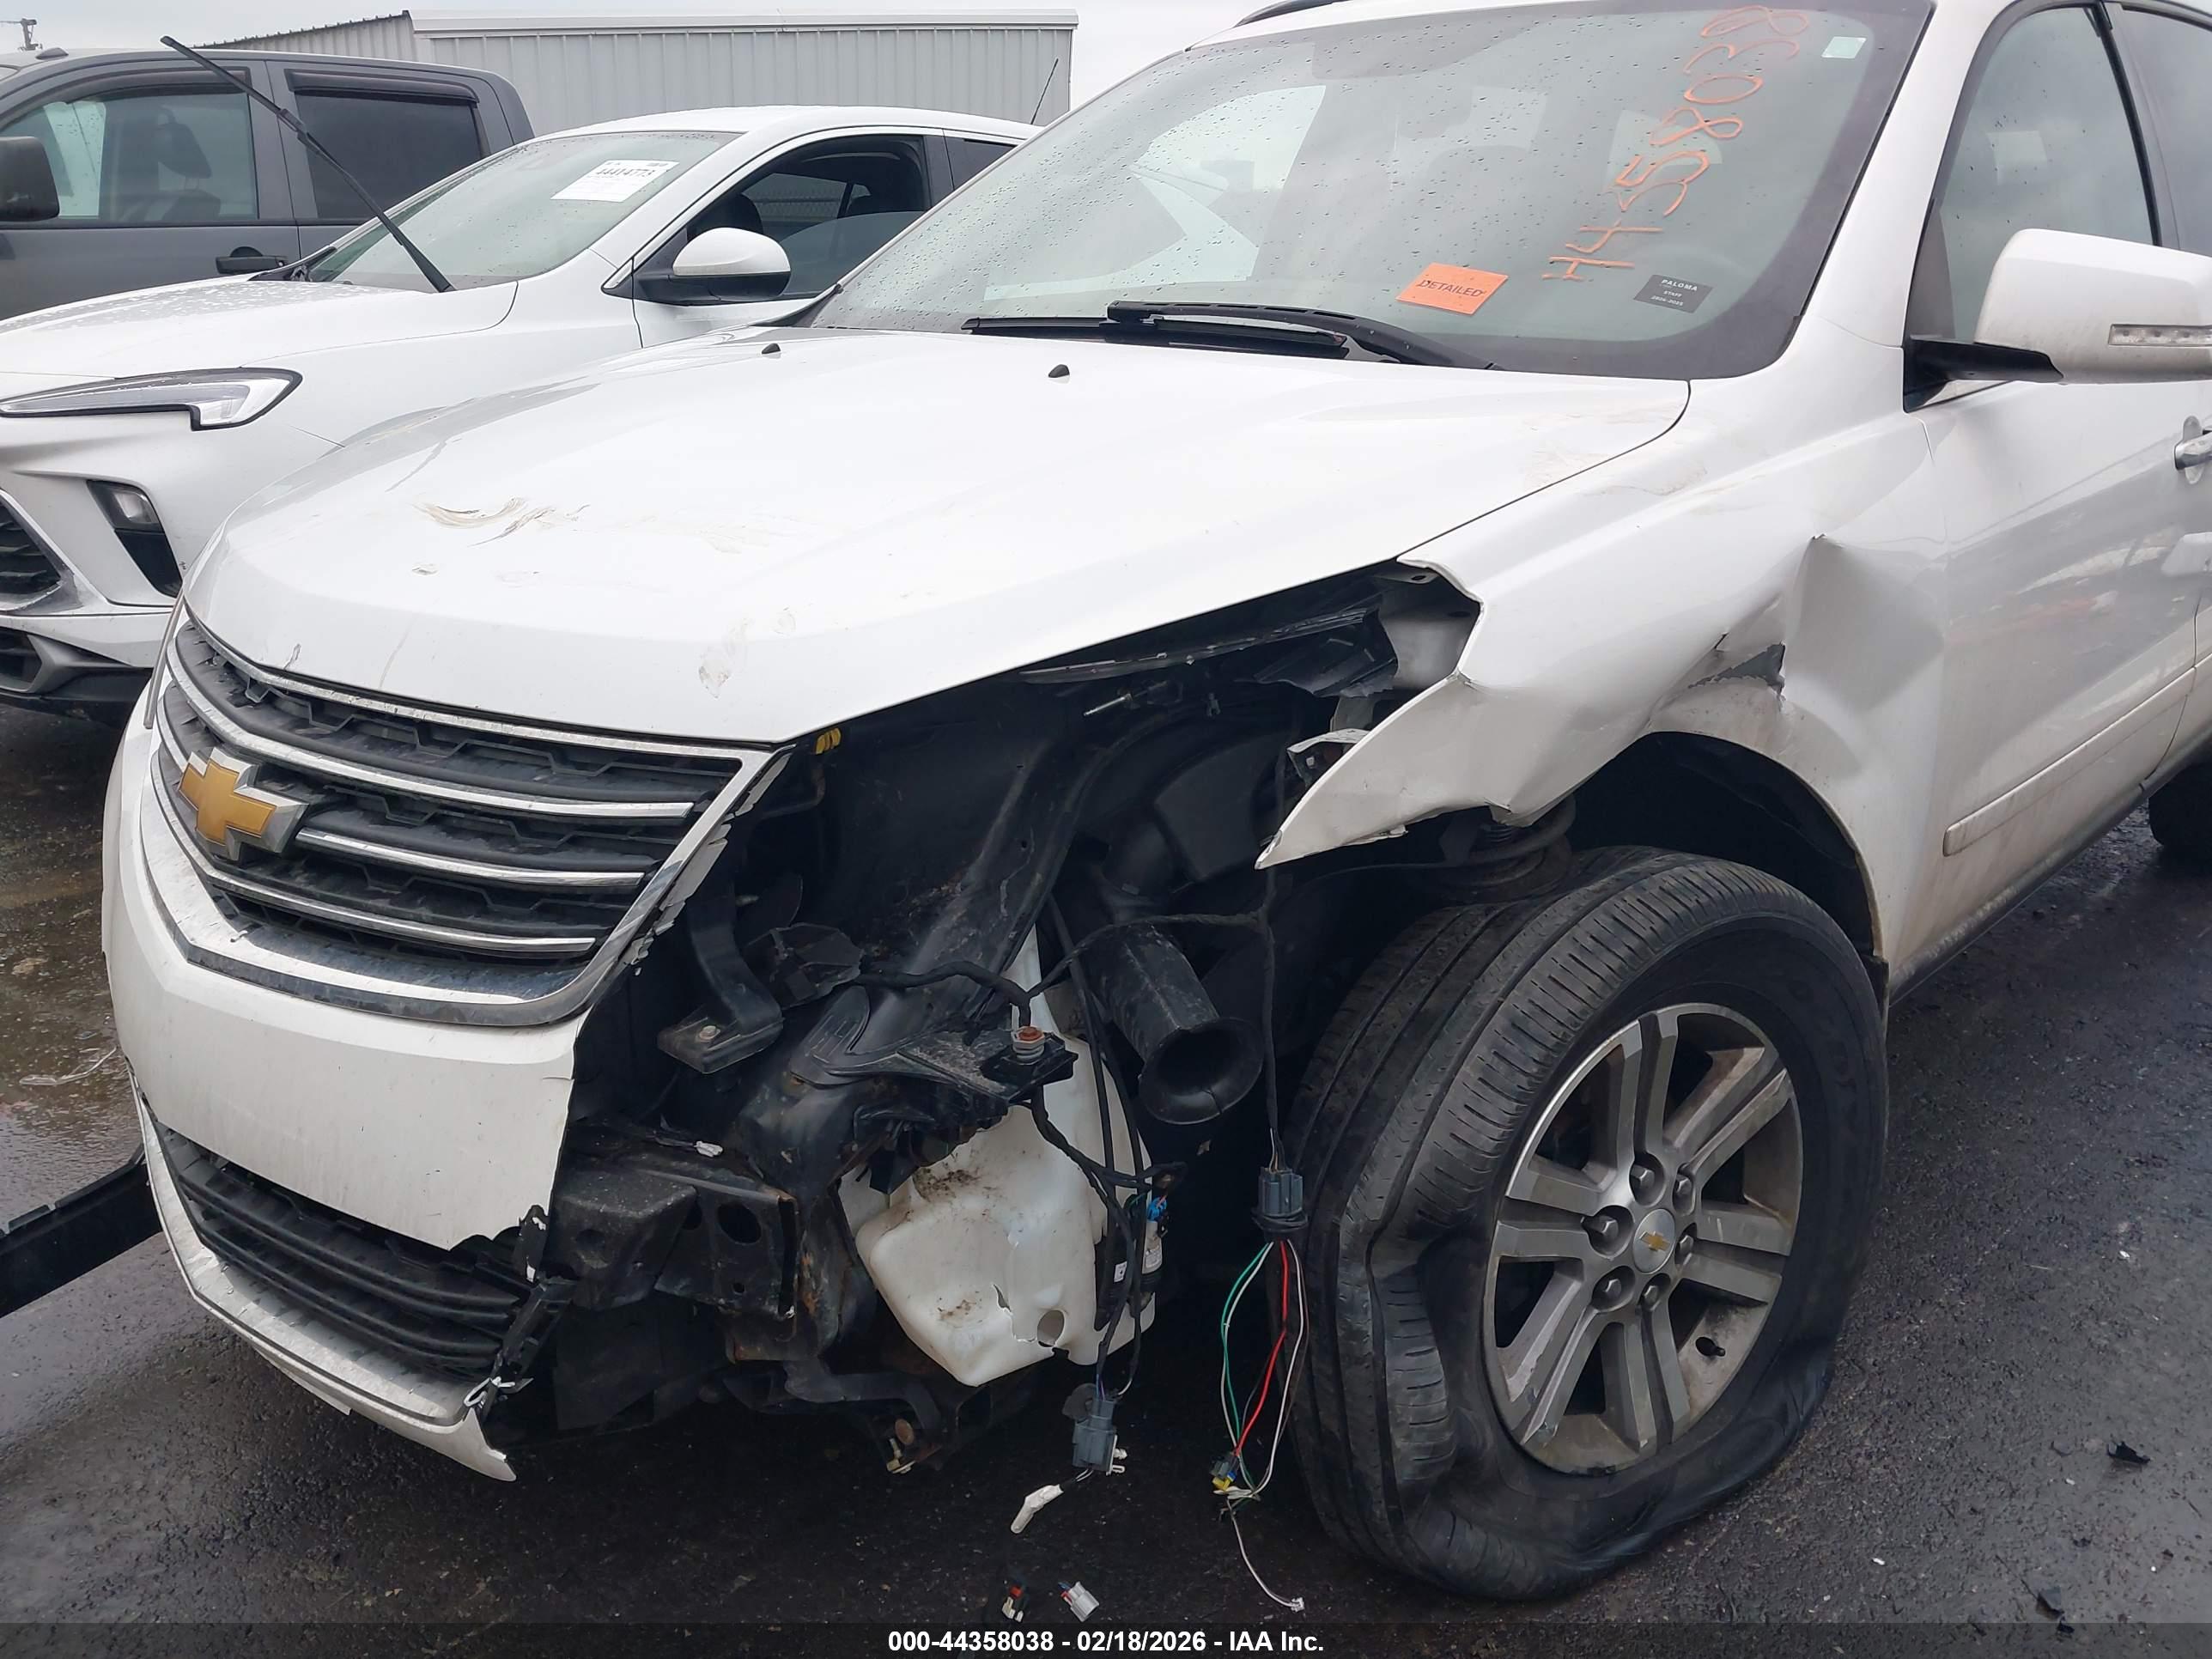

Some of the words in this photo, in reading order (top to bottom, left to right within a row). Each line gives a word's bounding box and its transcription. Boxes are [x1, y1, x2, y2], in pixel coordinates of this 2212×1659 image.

[1541, 4, 1809, 282] 44358038
[1416, 279, 1485, 297] DETAILED
[1661, 279, 1698, 291] PALOMA
